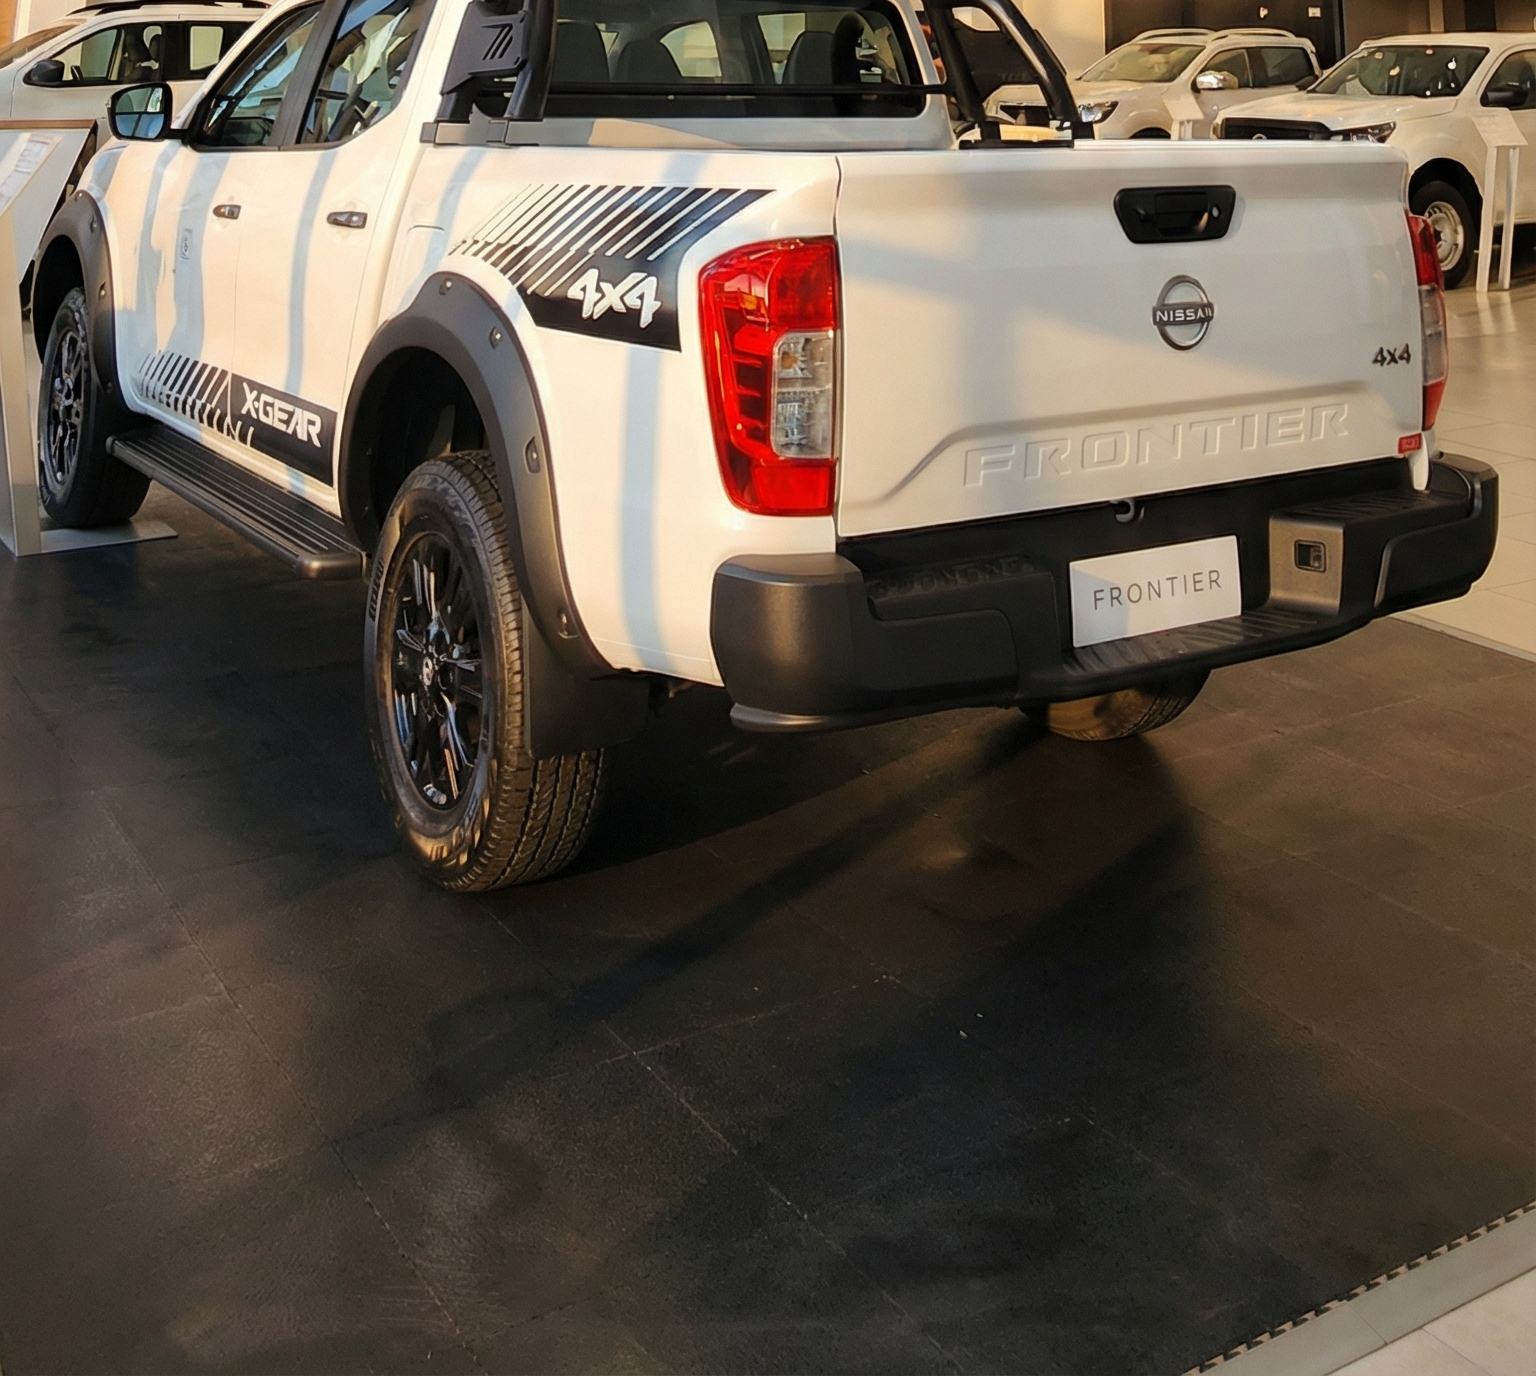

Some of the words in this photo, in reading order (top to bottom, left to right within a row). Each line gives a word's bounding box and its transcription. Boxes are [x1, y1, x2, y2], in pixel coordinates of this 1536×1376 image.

[1156, 307, 1212, 322] NISSAN
[963, 402, 1349, 488] FRONTIER
[1092, 569, 1222, 611] FRONTIER
